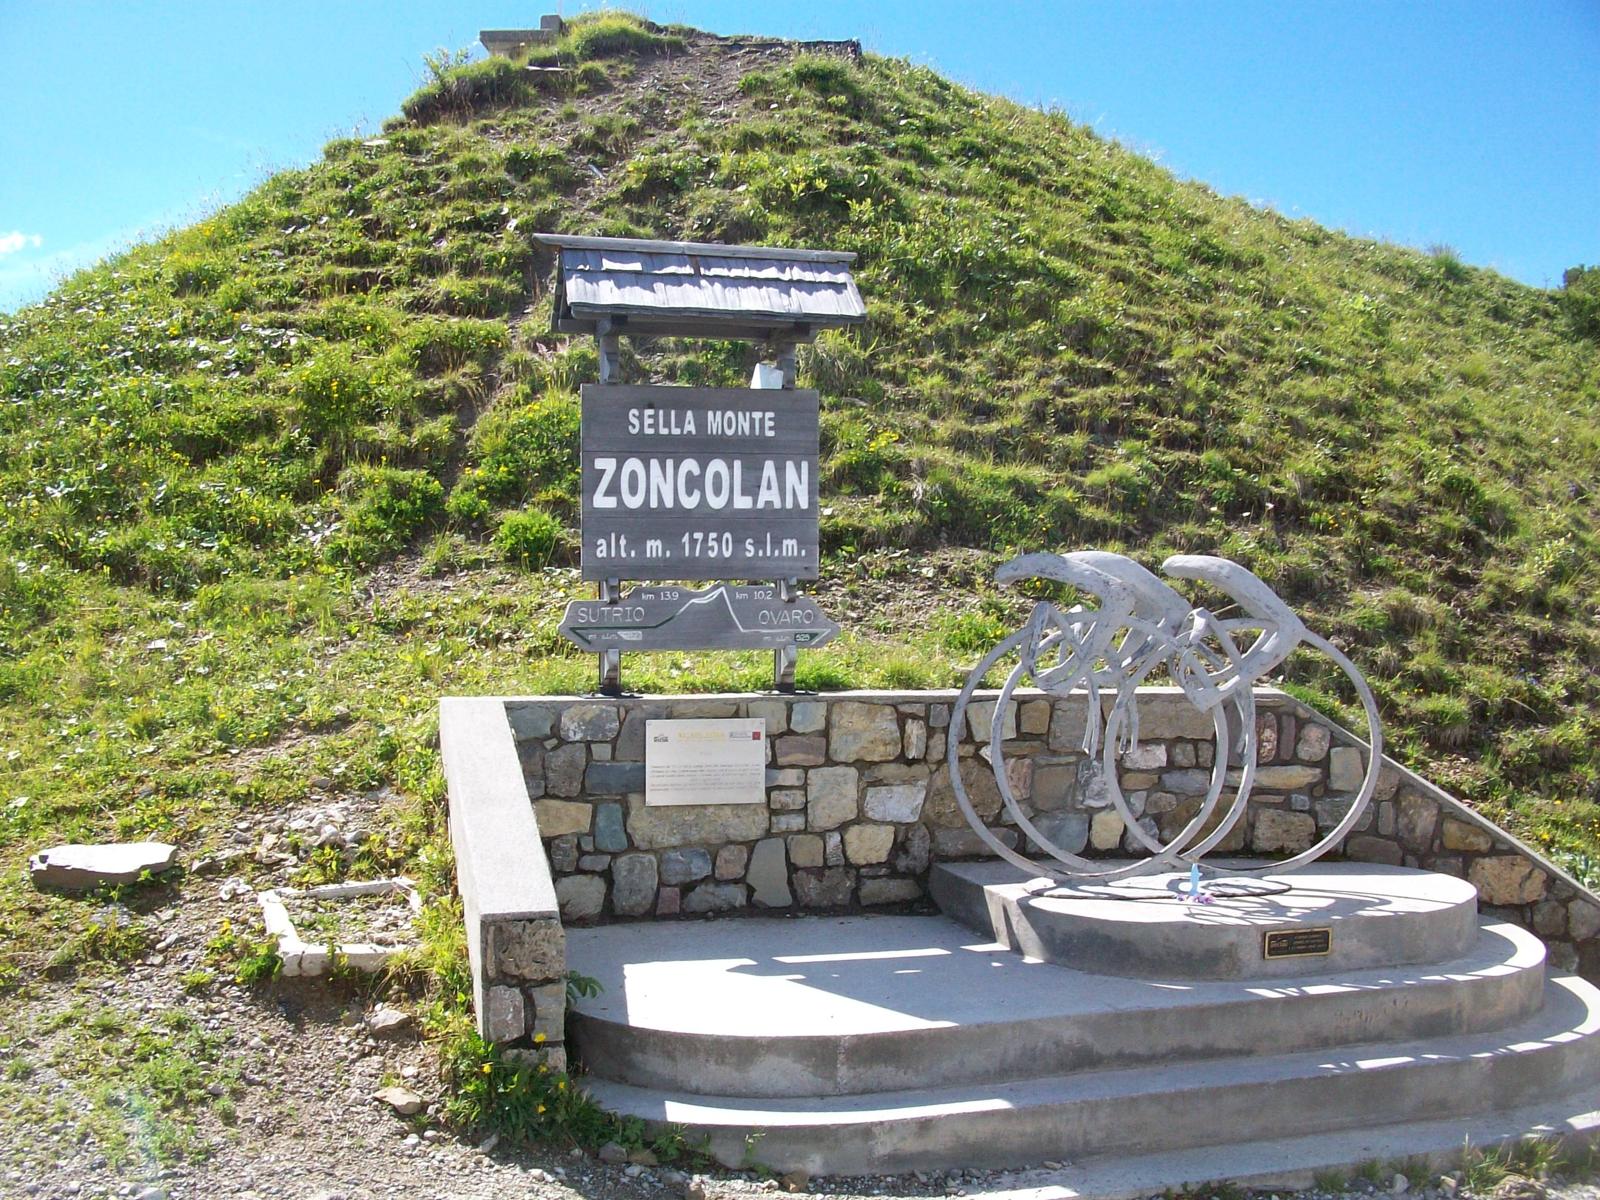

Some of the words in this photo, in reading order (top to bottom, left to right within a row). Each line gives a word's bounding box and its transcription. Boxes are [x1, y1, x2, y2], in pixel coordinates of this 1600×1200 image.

[628, 408, 696, 436] SELLA
[707, 410, 776, 437] MONTE
[592, 456, 809, 510] ZONCOLAN
[596, 532, 635, 558] alt.
[646, 540, 671, 558] m.
[681, 531, 733, 558] 1750
[745, 533, 807, 558] s.l.m.
[641, 592, 655, 601] km
[735, 591, 749, 600] km
[577, 607, 645, 623] SUTRIO
[758, 609, 814, 625] OVARO
